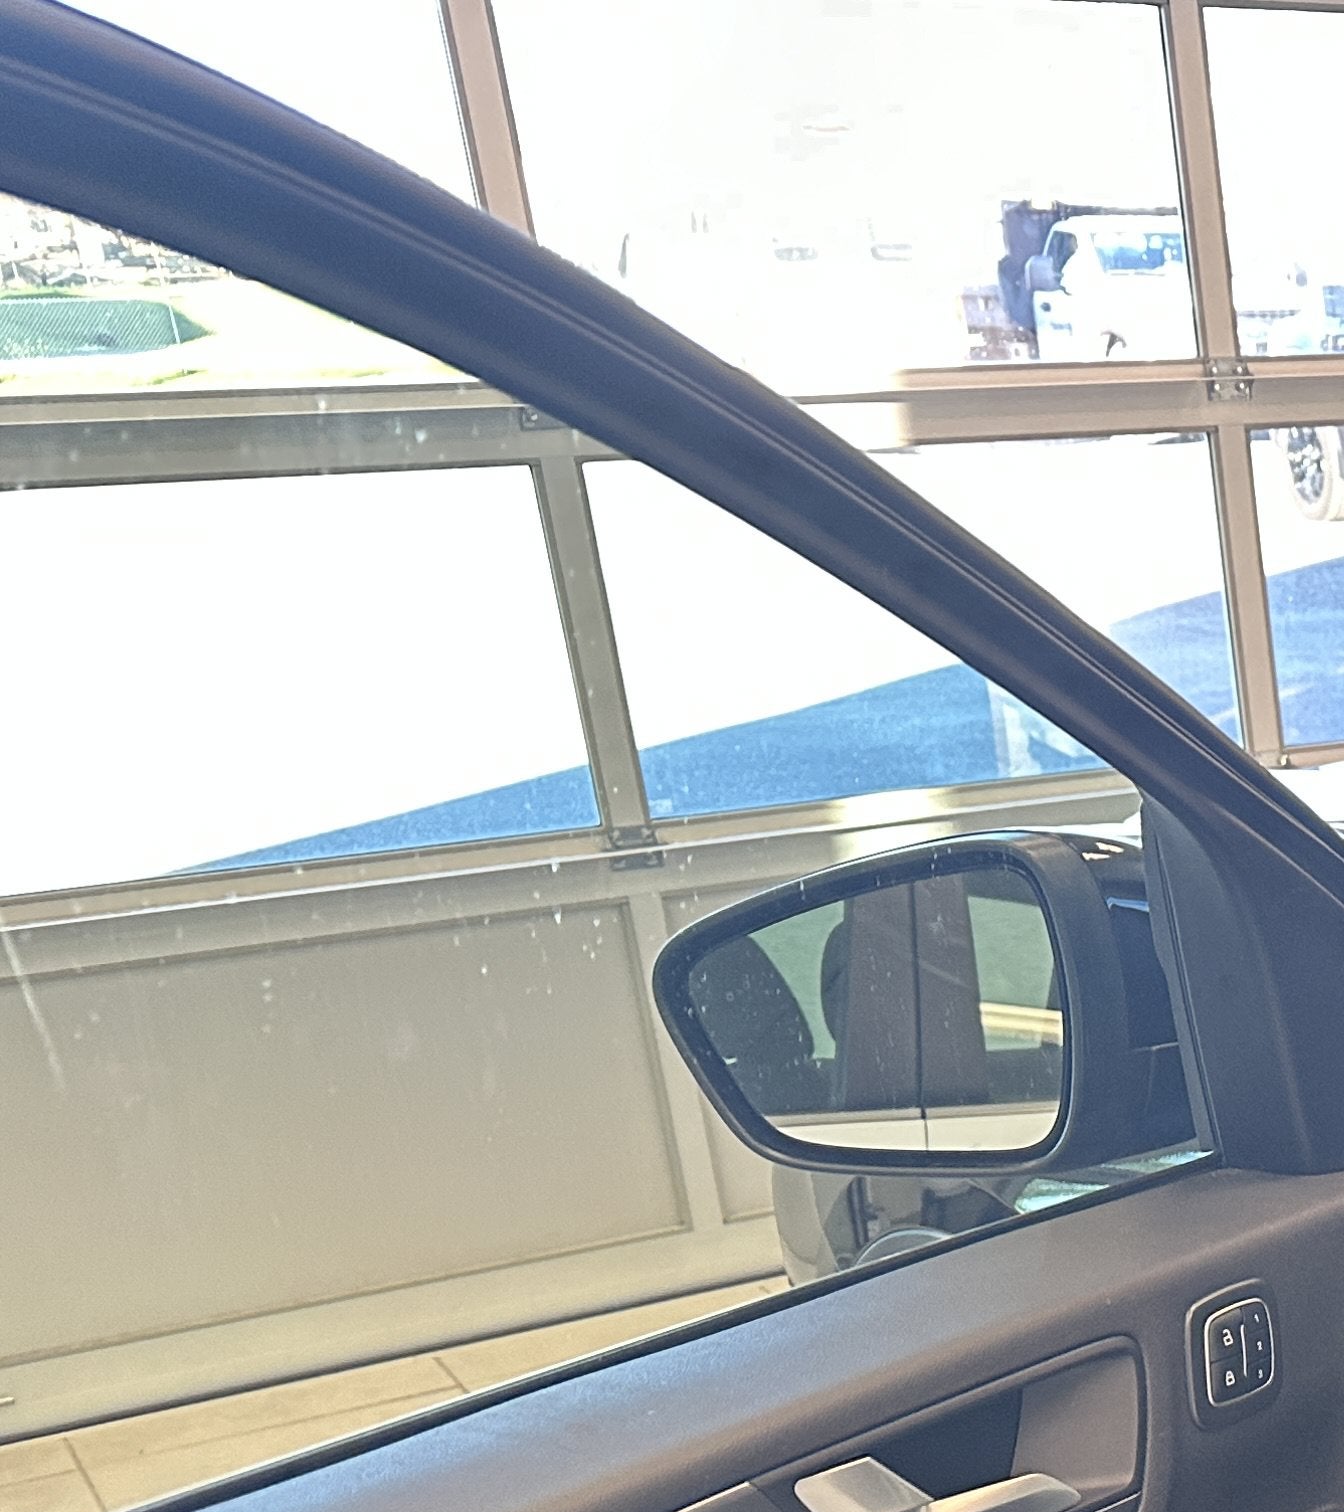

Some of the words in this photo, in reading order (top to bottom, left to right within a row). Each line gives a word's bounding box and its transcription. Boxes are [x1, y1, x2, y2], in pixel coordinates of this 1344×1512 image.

[1254, 1313, 1260, 1322] 1
[1257, 1341, 1263, 1350] 2
[1258, 1369, 1263, 1379] 3
